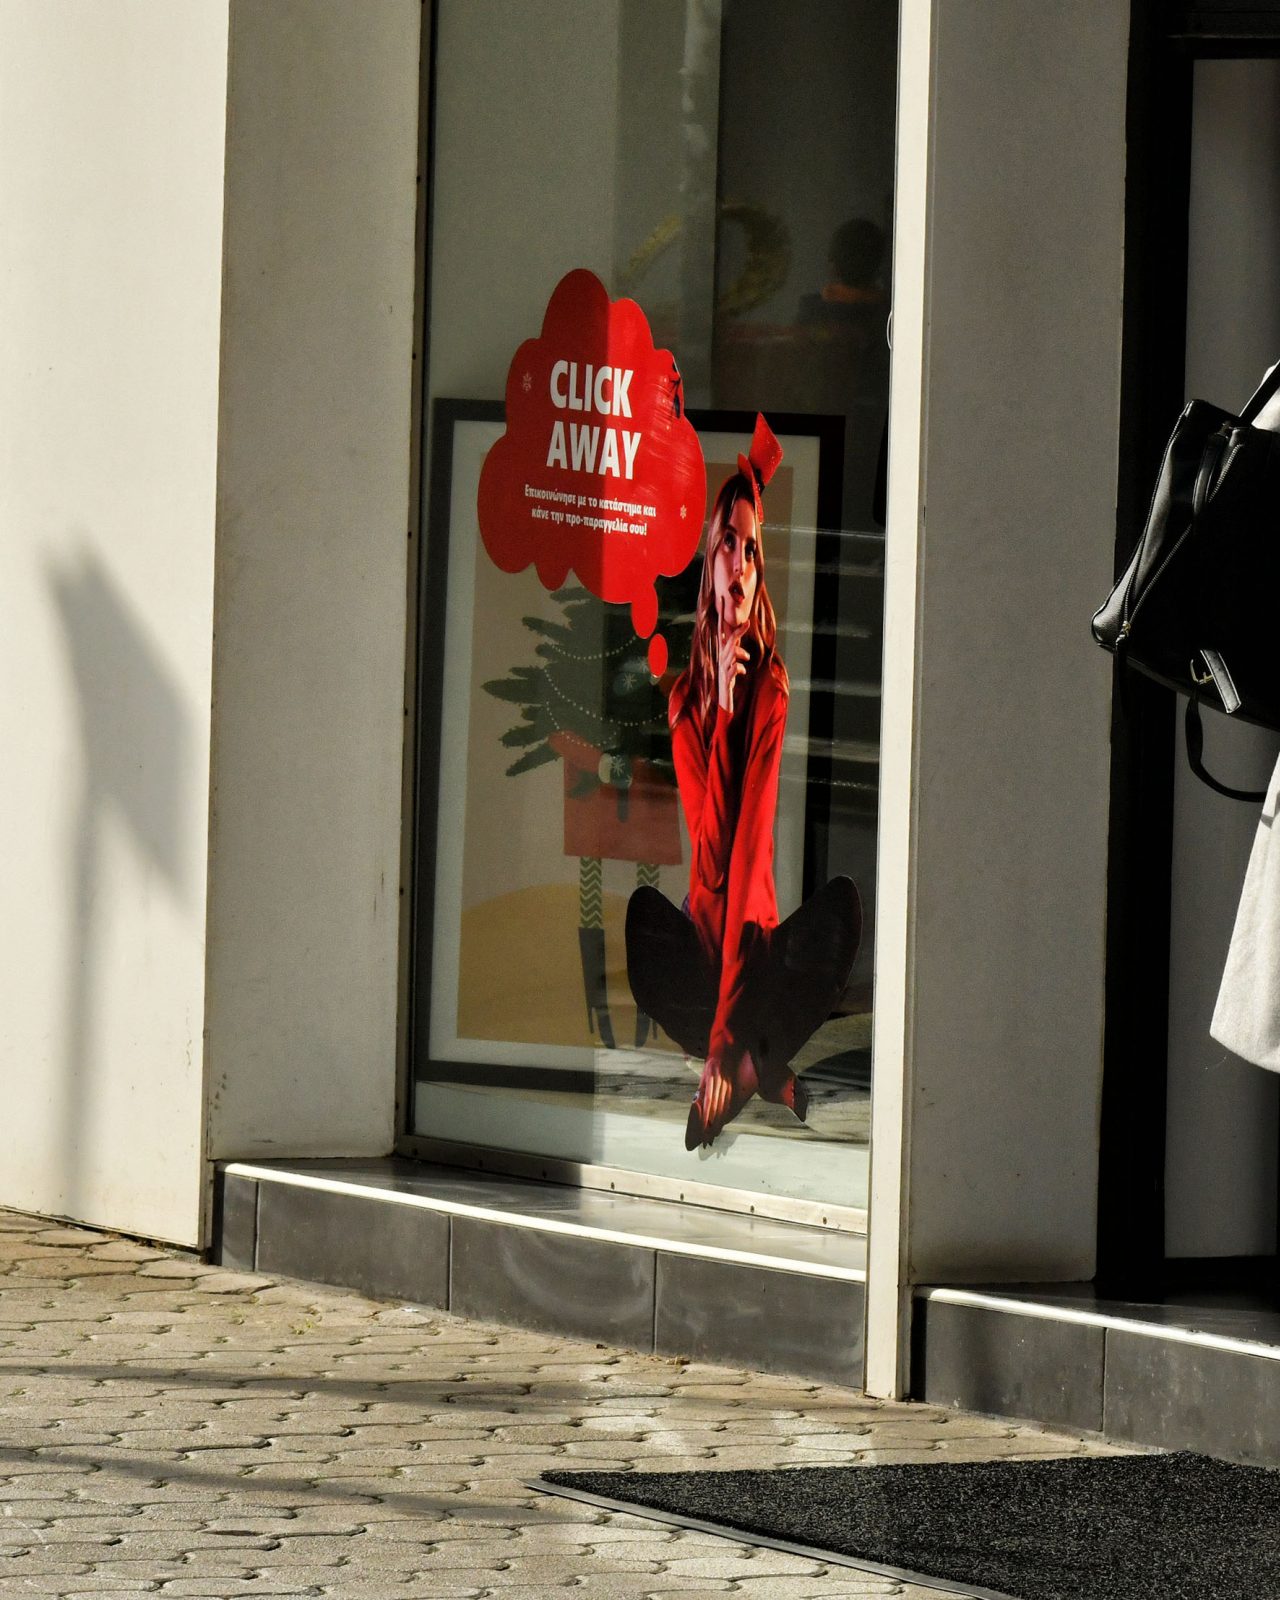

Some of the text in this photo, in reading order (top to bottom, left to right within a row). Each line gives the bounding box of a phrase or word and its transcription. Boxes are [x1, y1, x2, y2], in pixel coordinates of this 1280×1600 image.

[550, 360, 633, 418] CLICK
[546, 421, 641, 480] AWAY
[525, 484, 656, 517] Επικοινώνησε με το κατάστημα και
[531, 505, 647, 536] κάνε την προ-παραγγελία σου!
